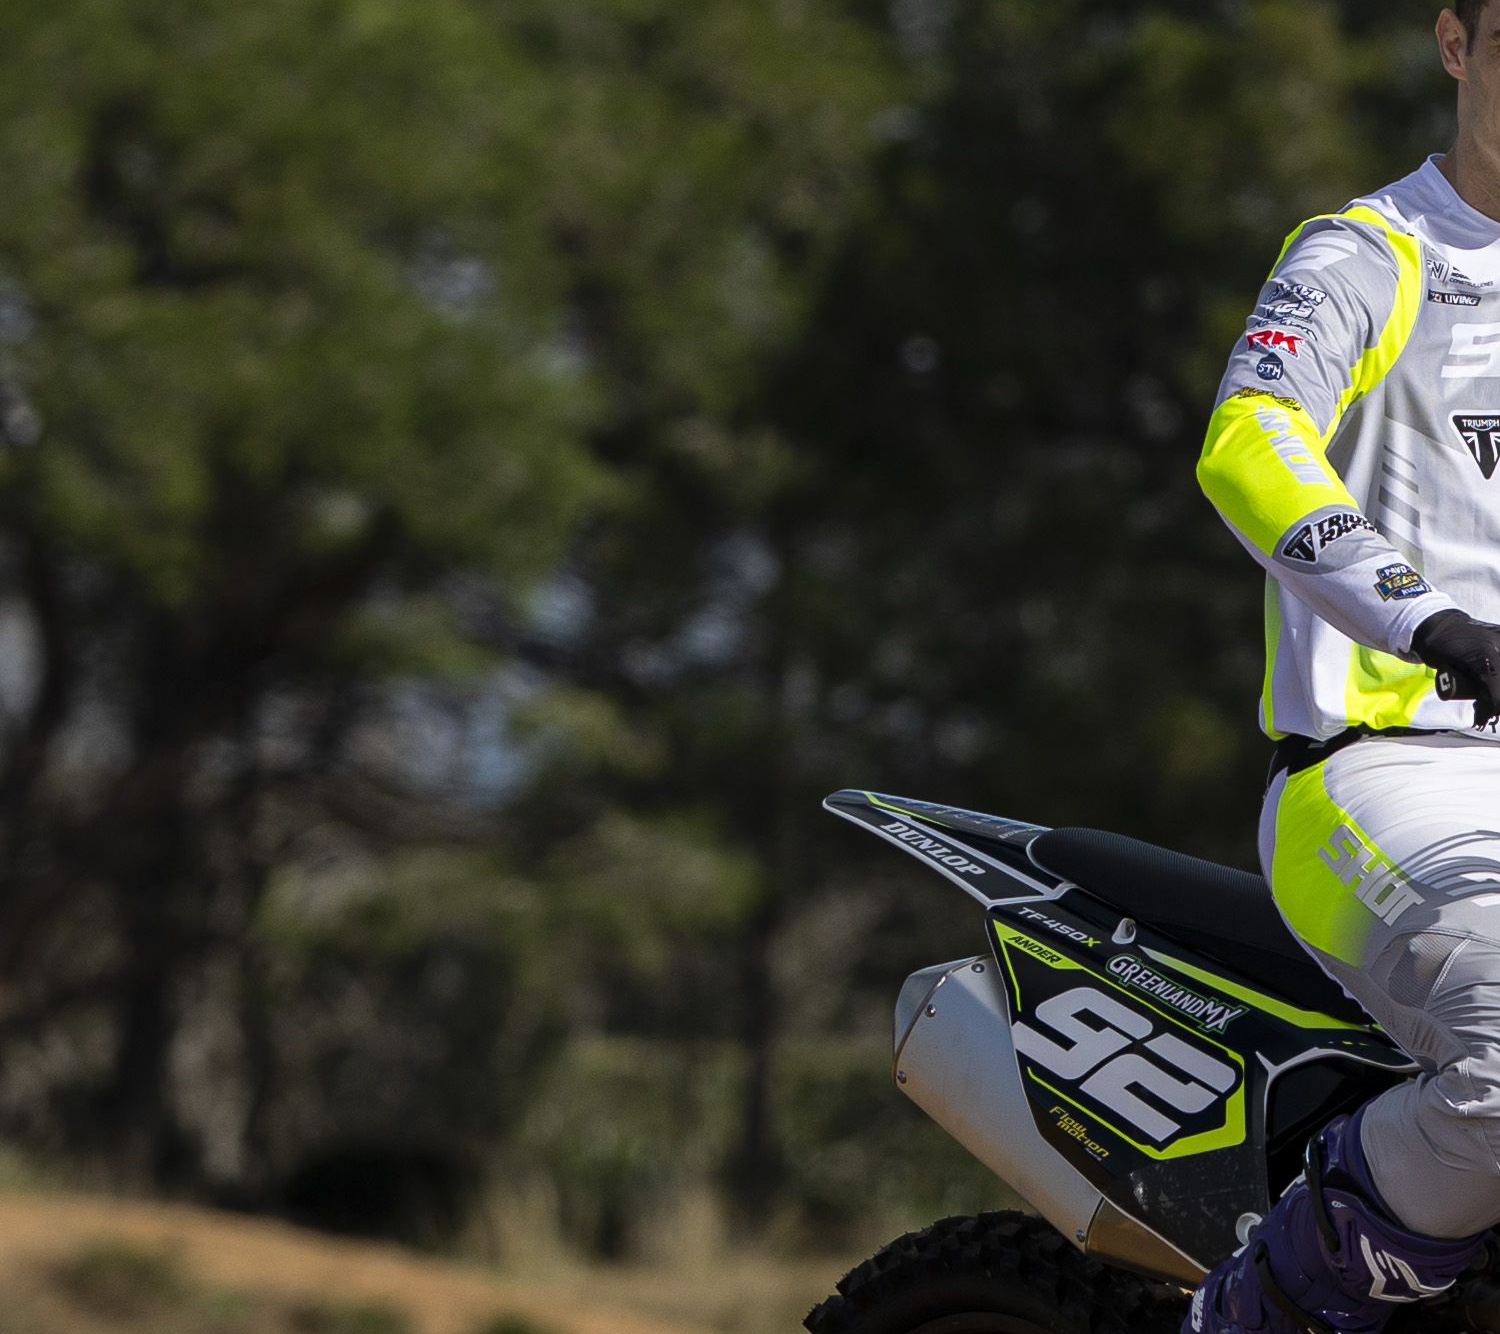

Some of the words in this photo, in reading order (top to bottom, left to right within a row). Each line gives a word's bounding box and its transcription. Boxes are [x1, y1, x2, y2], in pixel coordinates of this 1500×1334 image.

[1257, 362, 1282, 379] STM
[1462, 419, 1500, 428] TRIUMPH
[879, 821, 986, 876] DUNLOP
[1316, 823, 1426, 927] SHOT
[1008, 935, 1062, 964] ANDER
[1017, 906, 1102, 948] TF450X
[1109, 954, 1242, 1030] GREENLANDMX
[1011, 987, 1236, 1142] 92
